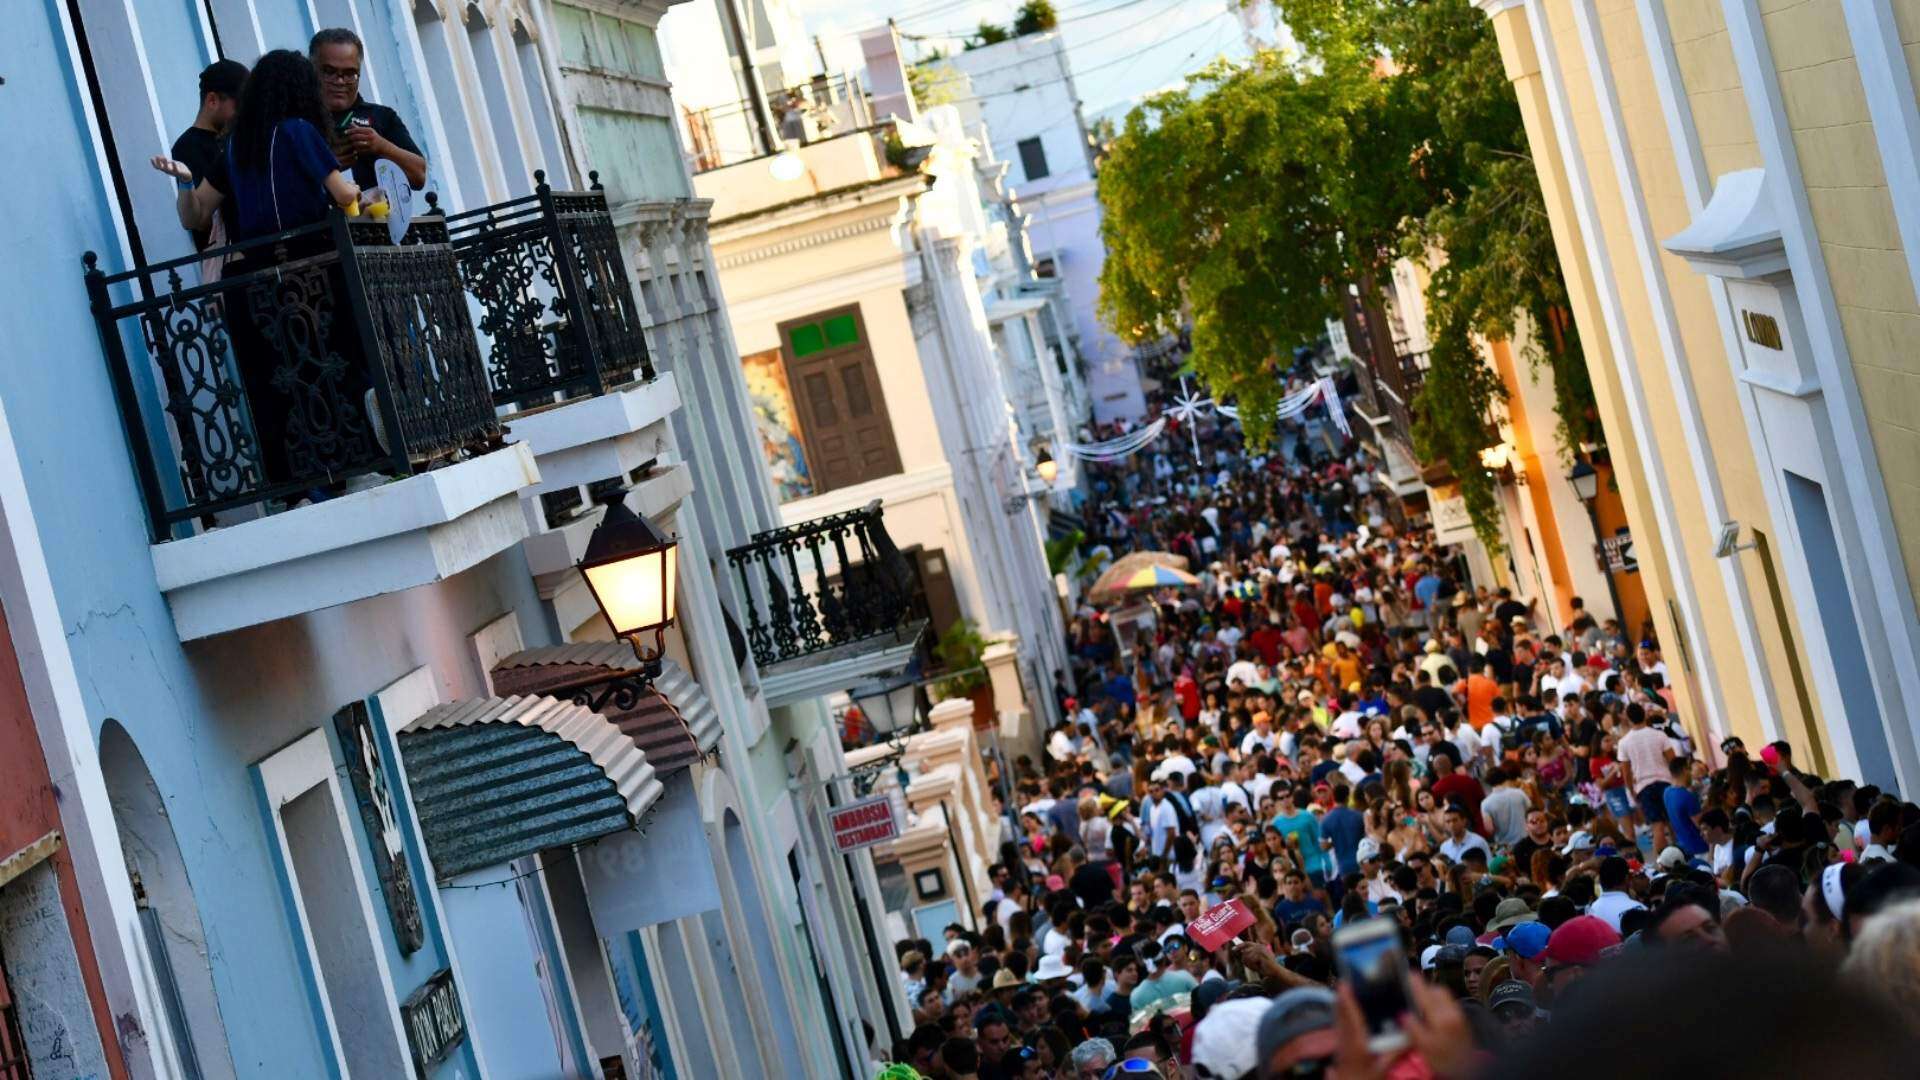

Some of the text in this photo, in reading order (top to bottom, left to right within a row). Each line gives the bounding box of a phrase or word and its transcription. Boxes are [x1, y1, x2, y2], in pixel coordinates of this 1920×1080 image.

[832, 802, 890, 832] AMBROSIA
[413, 980, 461, 1064] DON PABLO
